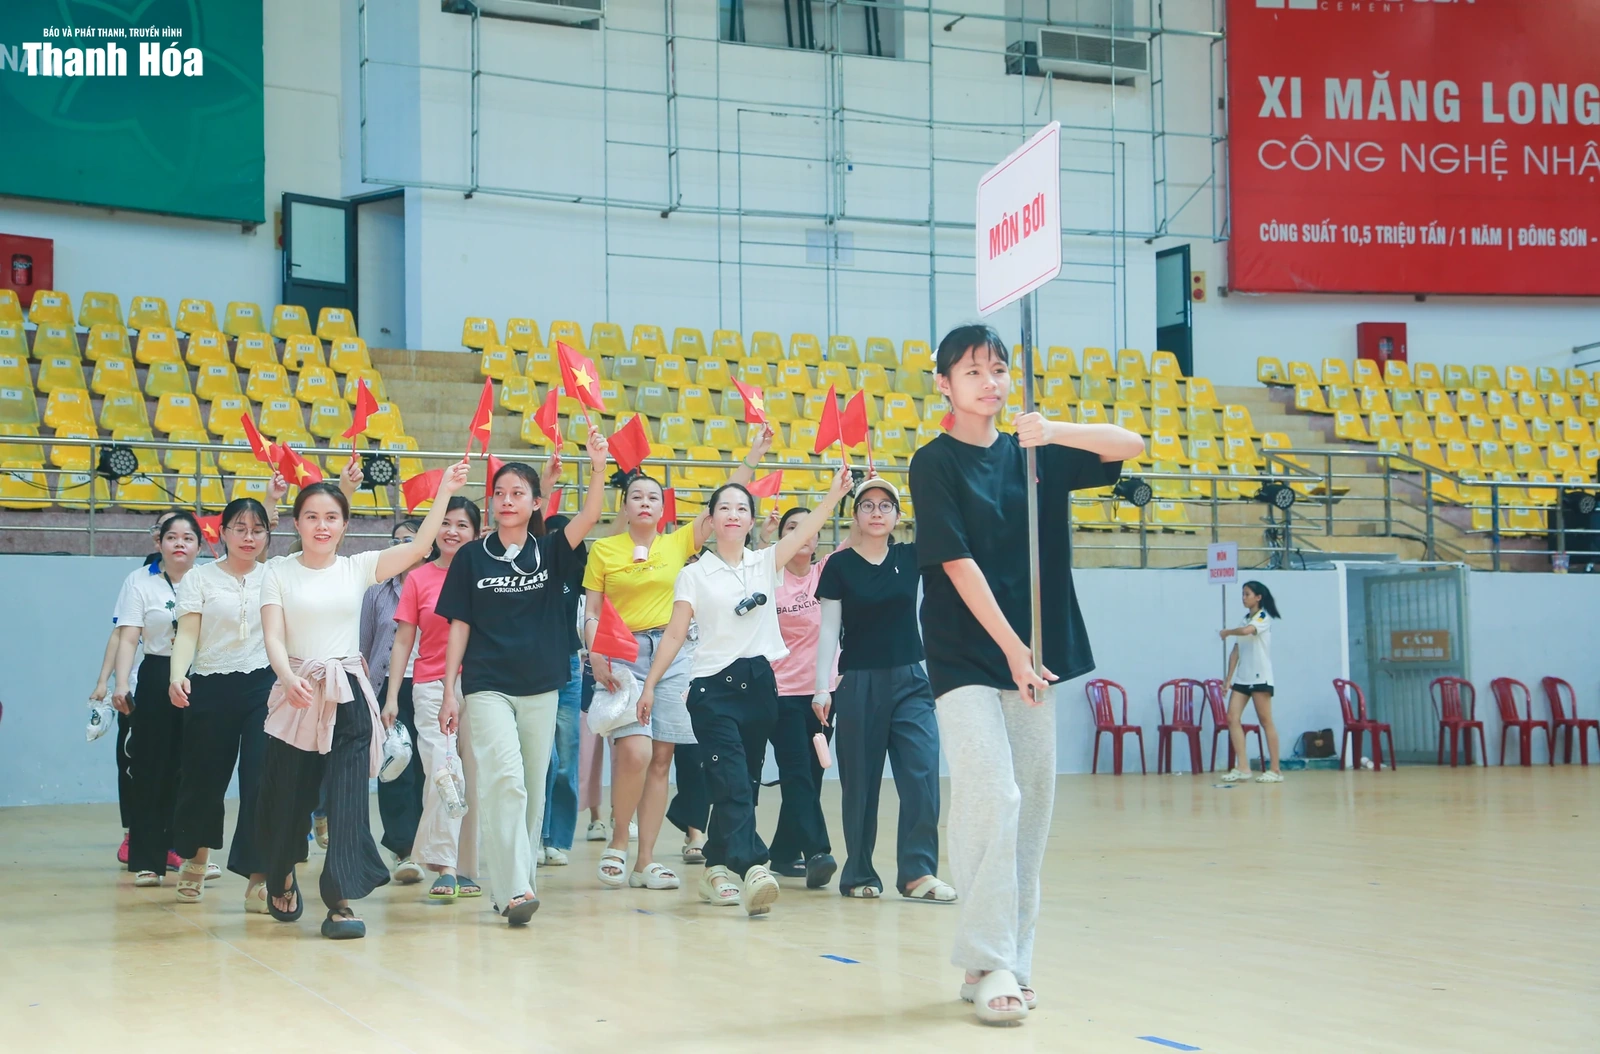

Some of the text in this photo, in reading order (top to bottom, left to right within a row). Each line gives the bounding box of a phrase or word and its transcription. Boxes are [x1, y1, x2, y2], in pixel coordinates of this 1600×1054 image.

[1320, 1, 1404, 12] CEMENT
[1258, 70, 1600, 126] XI MĂNG LONG
[1258, 134, 1386, 173] CÔNG
[1401, 138, 1509, 181] NGHỆ
[989, 192, 1045, 260] MÔN BƠI
[1259, 219, 1299, 243] CÔNG
[1302, 218, 1338, 243] SUẤT
[1341, 224, 1372, 247] 10,5
[1375, 221, 1416, 248] TRIỆU
[1418, 220, 1447, 245] TẤN
[1459, 227, 1466, 245] 1
[1471, 224, 1503, 246] NĂM
[1517, 223, 1556, 247] ĐÔNG
[1559, 226, 1588, 247] SƠN
[476, 575, 519, 590] CBX
[493, 582, 545, 594] ORIGINAL BRAND
